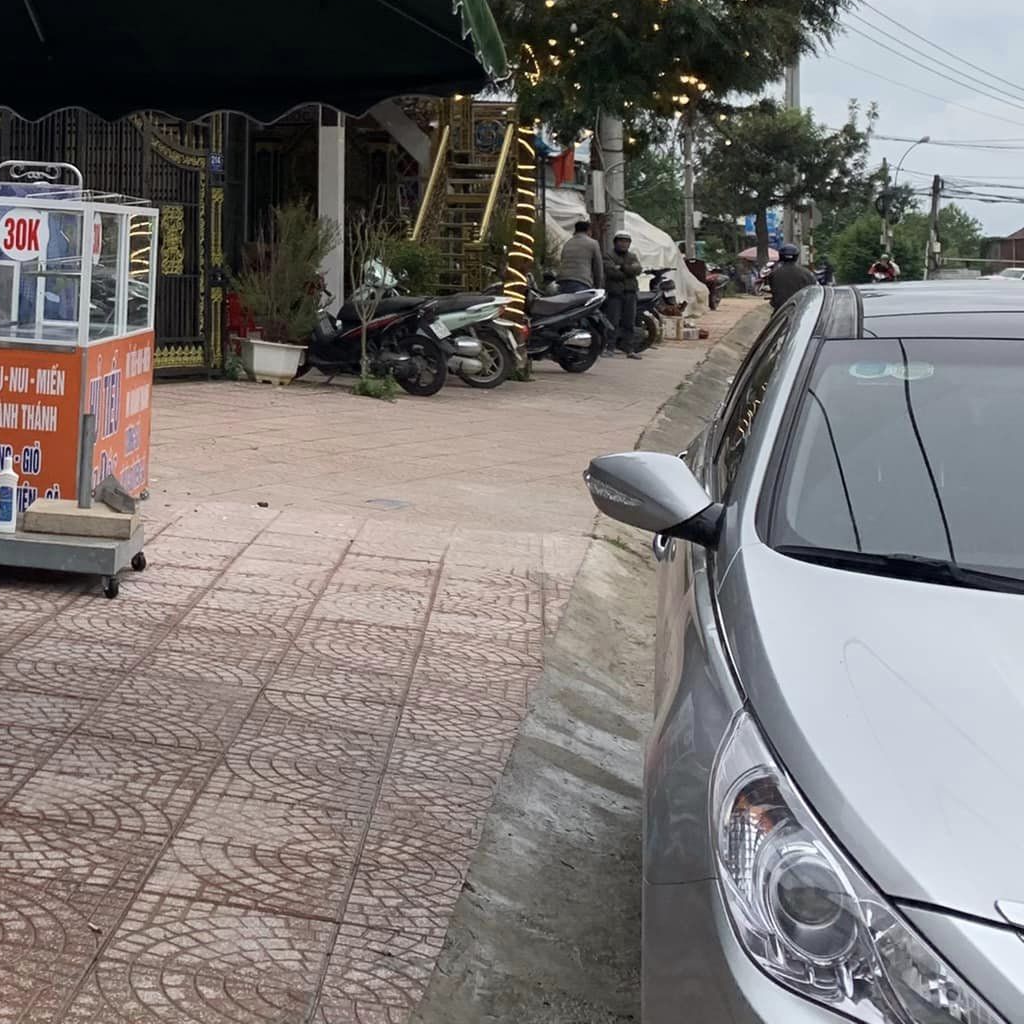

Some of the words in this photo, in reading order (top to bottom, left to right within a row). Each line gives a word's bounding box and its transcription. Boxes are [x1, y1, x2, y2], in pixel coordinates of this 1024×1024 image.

[3, 217, 41, 253] 30K
[9, 366, 29, 393] NUI
[36, 363, 65, 396] MIẾN
[21, 401, 58, 432] THÁNH
